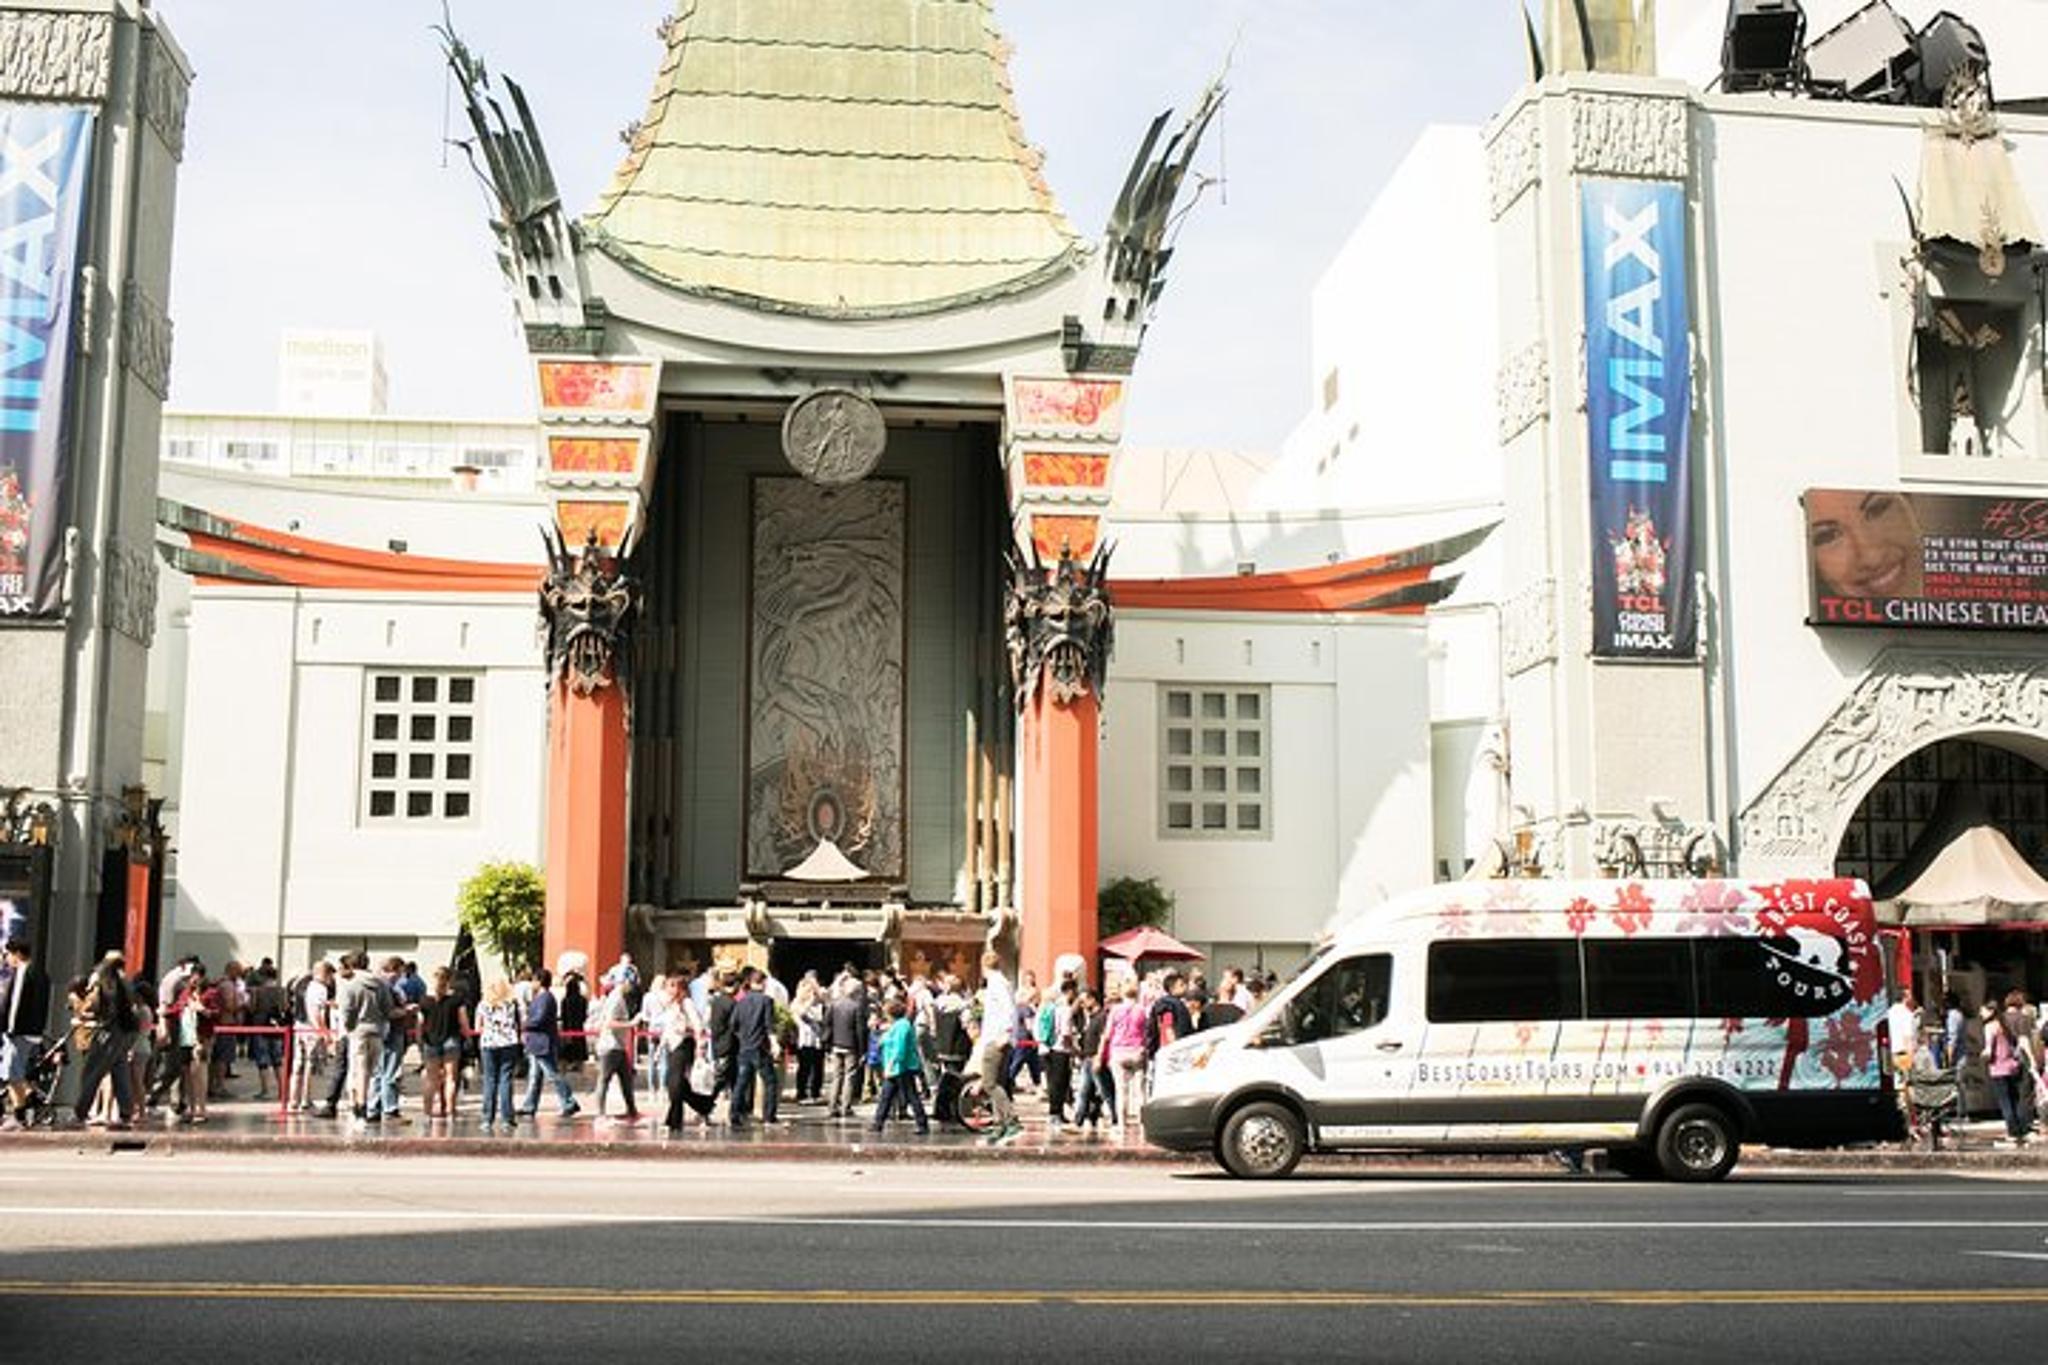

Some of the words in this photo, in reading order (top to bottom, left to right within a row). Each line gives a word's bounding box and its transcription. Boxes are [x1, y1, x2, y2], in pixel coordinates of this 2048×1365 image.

[1603, 201, 1668, 482] IMAX
[1617, 595, 1665, 612] TCL
[1820, 597, 1884, 621] TCL
[1885, 600, 1983, 624] CHINESE
[1987, 602, 2048, 626] THEA
[1614, 633, 1674, 650] IMAX
[1765, 892, 1815, 926] BEST
[1824, 897, 1868, 956] COAST
[1765, 955, 1844, 1000] TOURS
